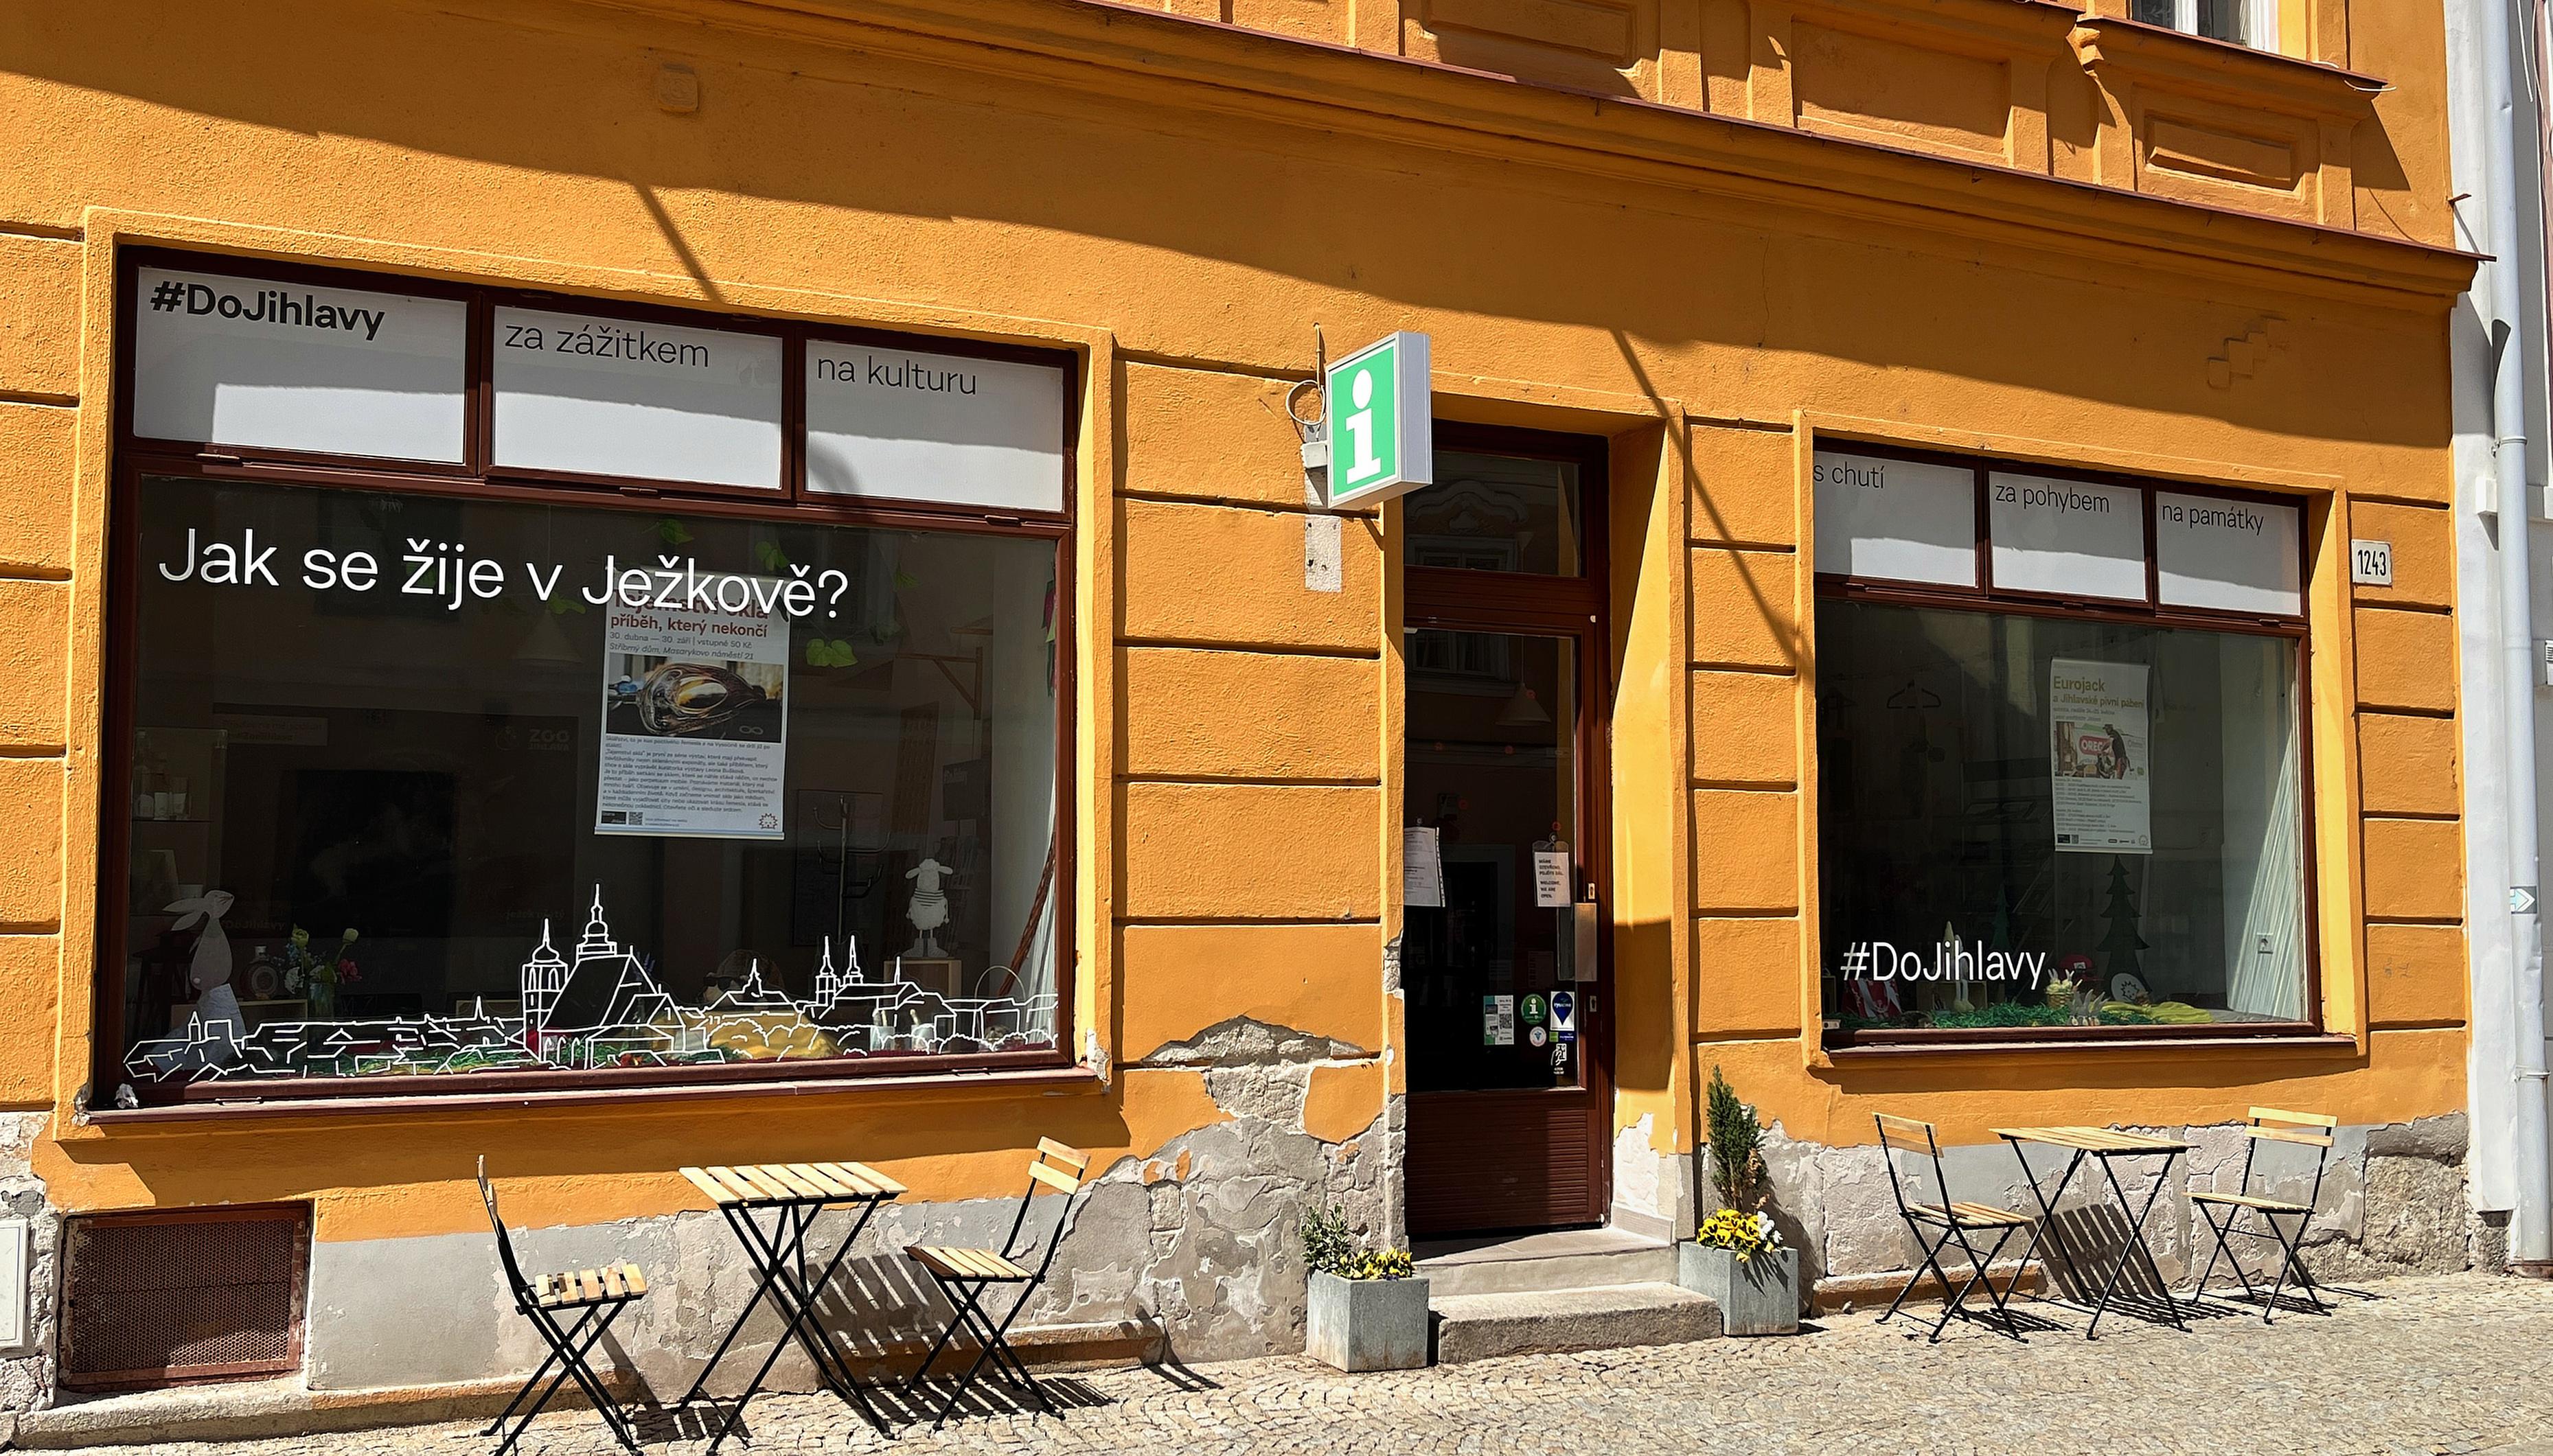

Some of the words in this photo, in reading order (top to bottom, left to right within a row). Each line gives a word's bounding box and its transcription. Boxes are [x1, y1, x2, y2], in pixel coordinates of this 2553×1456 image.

[150, 281, 385, 341] #DoJihlavy
[505, 325, 543, 350] za
[556, 324, 709, 367] zážitkem
[818, 358, 856, 383] na
[868, 356, 976, 395] kulturu
[1813, 465, 1824, 482] s
[1832, 461, 1884, 489] chutí
[1995, 484, 2017, 504] za
[2023, 485, 2110, 515] pohybem
[2162, 504, 2184, 524] na
[2189, 507, 2264, 536] památky
[159, 529, 279, 586] Jak
[303, 549, 378, 591] se
[401, 538, 504, 610] žije
[526, 562, 563, 601] v
[582, 555, 849, 618] Ježkově?
[2358, 549, 2387, 577] 1243
[610, 615, 663, 632] příběh,
[667, 617, 707, 635] který
[711, 623, 768, 638] nekončí
[624, 632, 649, 641] dubna
[697, 639, 729, 648] vstupné
[730, 640, 740, 648] 50
[663, 647, 710, 657] Masarykovo
[711, 650, 743, 658] náměstí
[2053, 676, 2106, 693] Eurojack
[2060, 694, 2098, 706] Jihlavské
[529, 729, 571, 743] ZOO
[1840, 940, 2046, 990] #DoJihlavy
